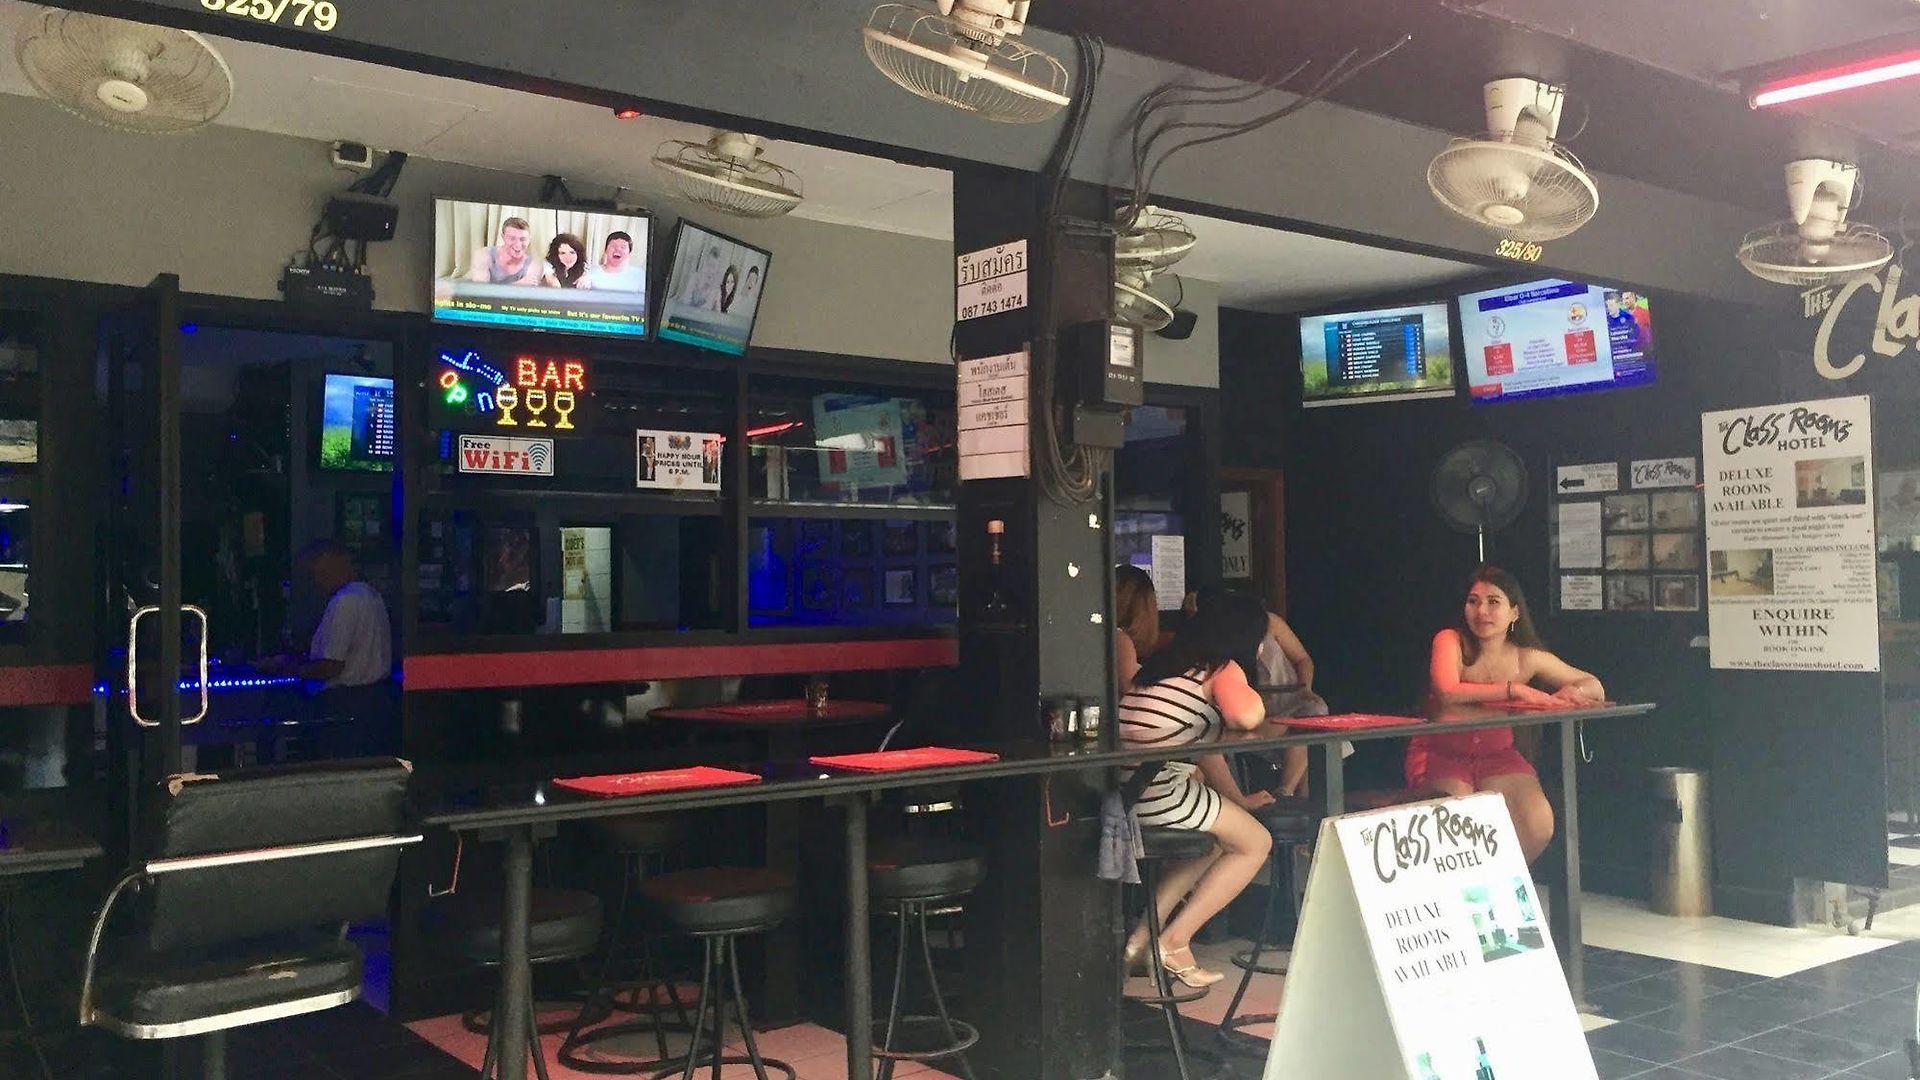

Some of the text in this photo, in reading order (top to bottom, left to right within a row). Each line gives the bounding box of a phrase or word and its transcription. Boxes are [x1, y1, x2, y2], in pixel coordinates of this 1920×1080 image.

[1495, 239, 1543, 261] 325/80
[960, 245, 1023, 283] รับสมัคร
[961, 294, 1022, 319] 087 743 1474
[1800, 264, 1920, 380] THE Cla
[518, 358, 585, 391] BAR
[463, 439, 491, 449] Free
[1722, 411, 1786, 456] Class
[1777, 436, 1827, 452] HOTEL
[463, 449, 531, 471] WiFi
[655, 460, 680, 468] PRICES
[657, 452, 701, 461] HAPPY HOUR
[1718, 467, 1774, 483] DELUXE
[1722, 483, 1772, 497] ROOMS
[1710, 498, 1785, 514] AVAILABLE
[1752, 608, 1836, 622] ENQUIRE
[1759, 625, 1829, 637] WITHIN
[1763, 645, 1825, 653] BOOK ONLINE
[1729, 659, 1864, 670] www.theclassroomshotel.com
[1360, 827, 1374, 846] THE
[1373, 813, 1430, 883] Class
[1433, 849, 1483, 874] HOTEL
[1384, 901, 1442, 929] DELUXE
[1395, 928, 1451, 955] ROOMS
[1394, 950, 1469, 984] AVAILABLE
